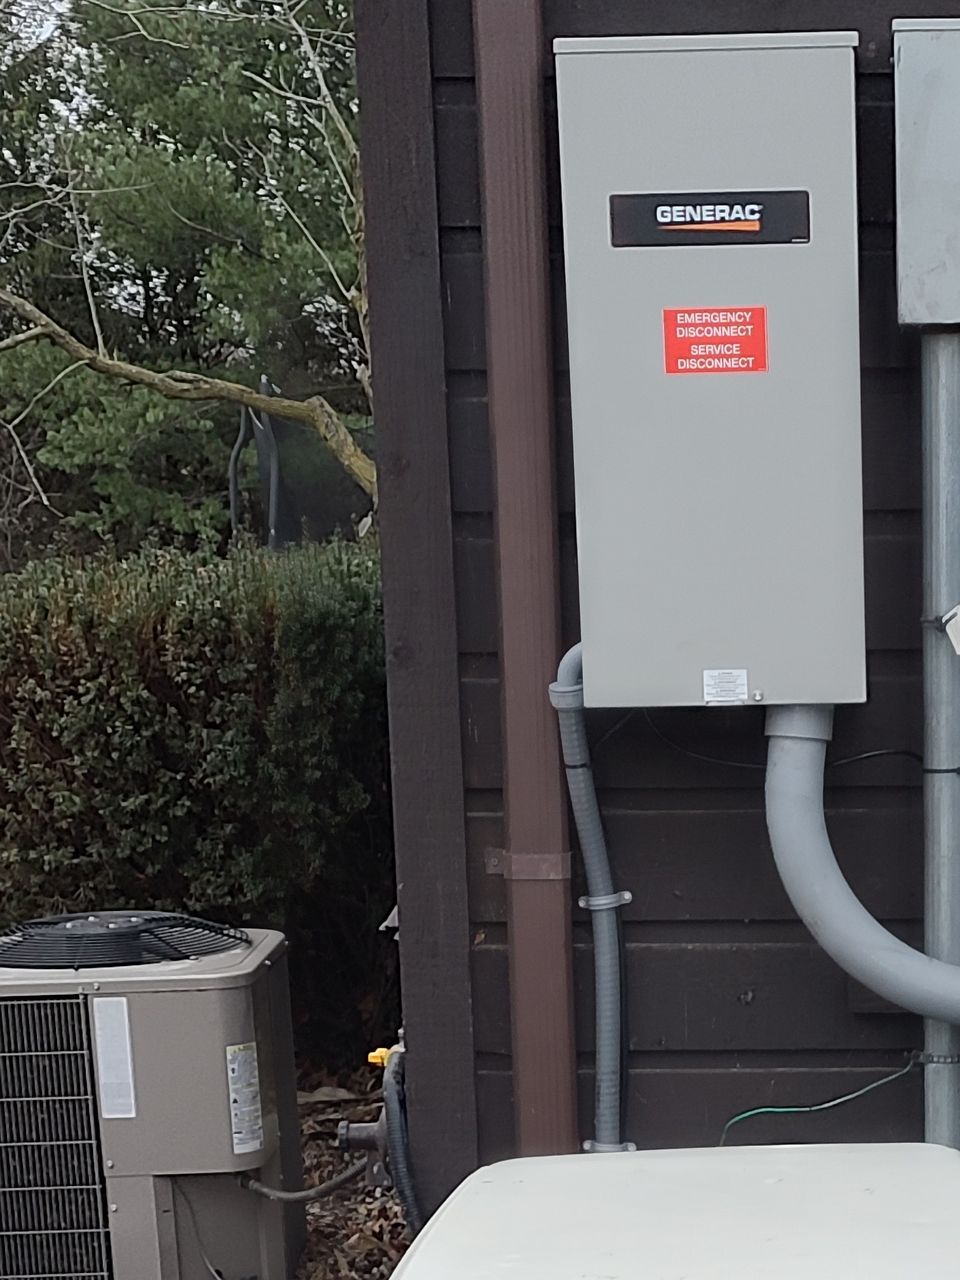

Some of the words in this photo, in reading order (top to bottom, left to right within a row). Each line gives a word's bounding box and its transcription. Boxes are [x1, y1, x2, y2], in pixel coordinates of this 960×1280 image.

[656, 204, 762, 223] GENERAC
[677, 312, 752, 324] EMERGENCY
[676, 325, 754, 338] DISCONNECT
[690, 344, 741, 355] SERVICE
[677, 357, 755, 370] DISCONNECT
